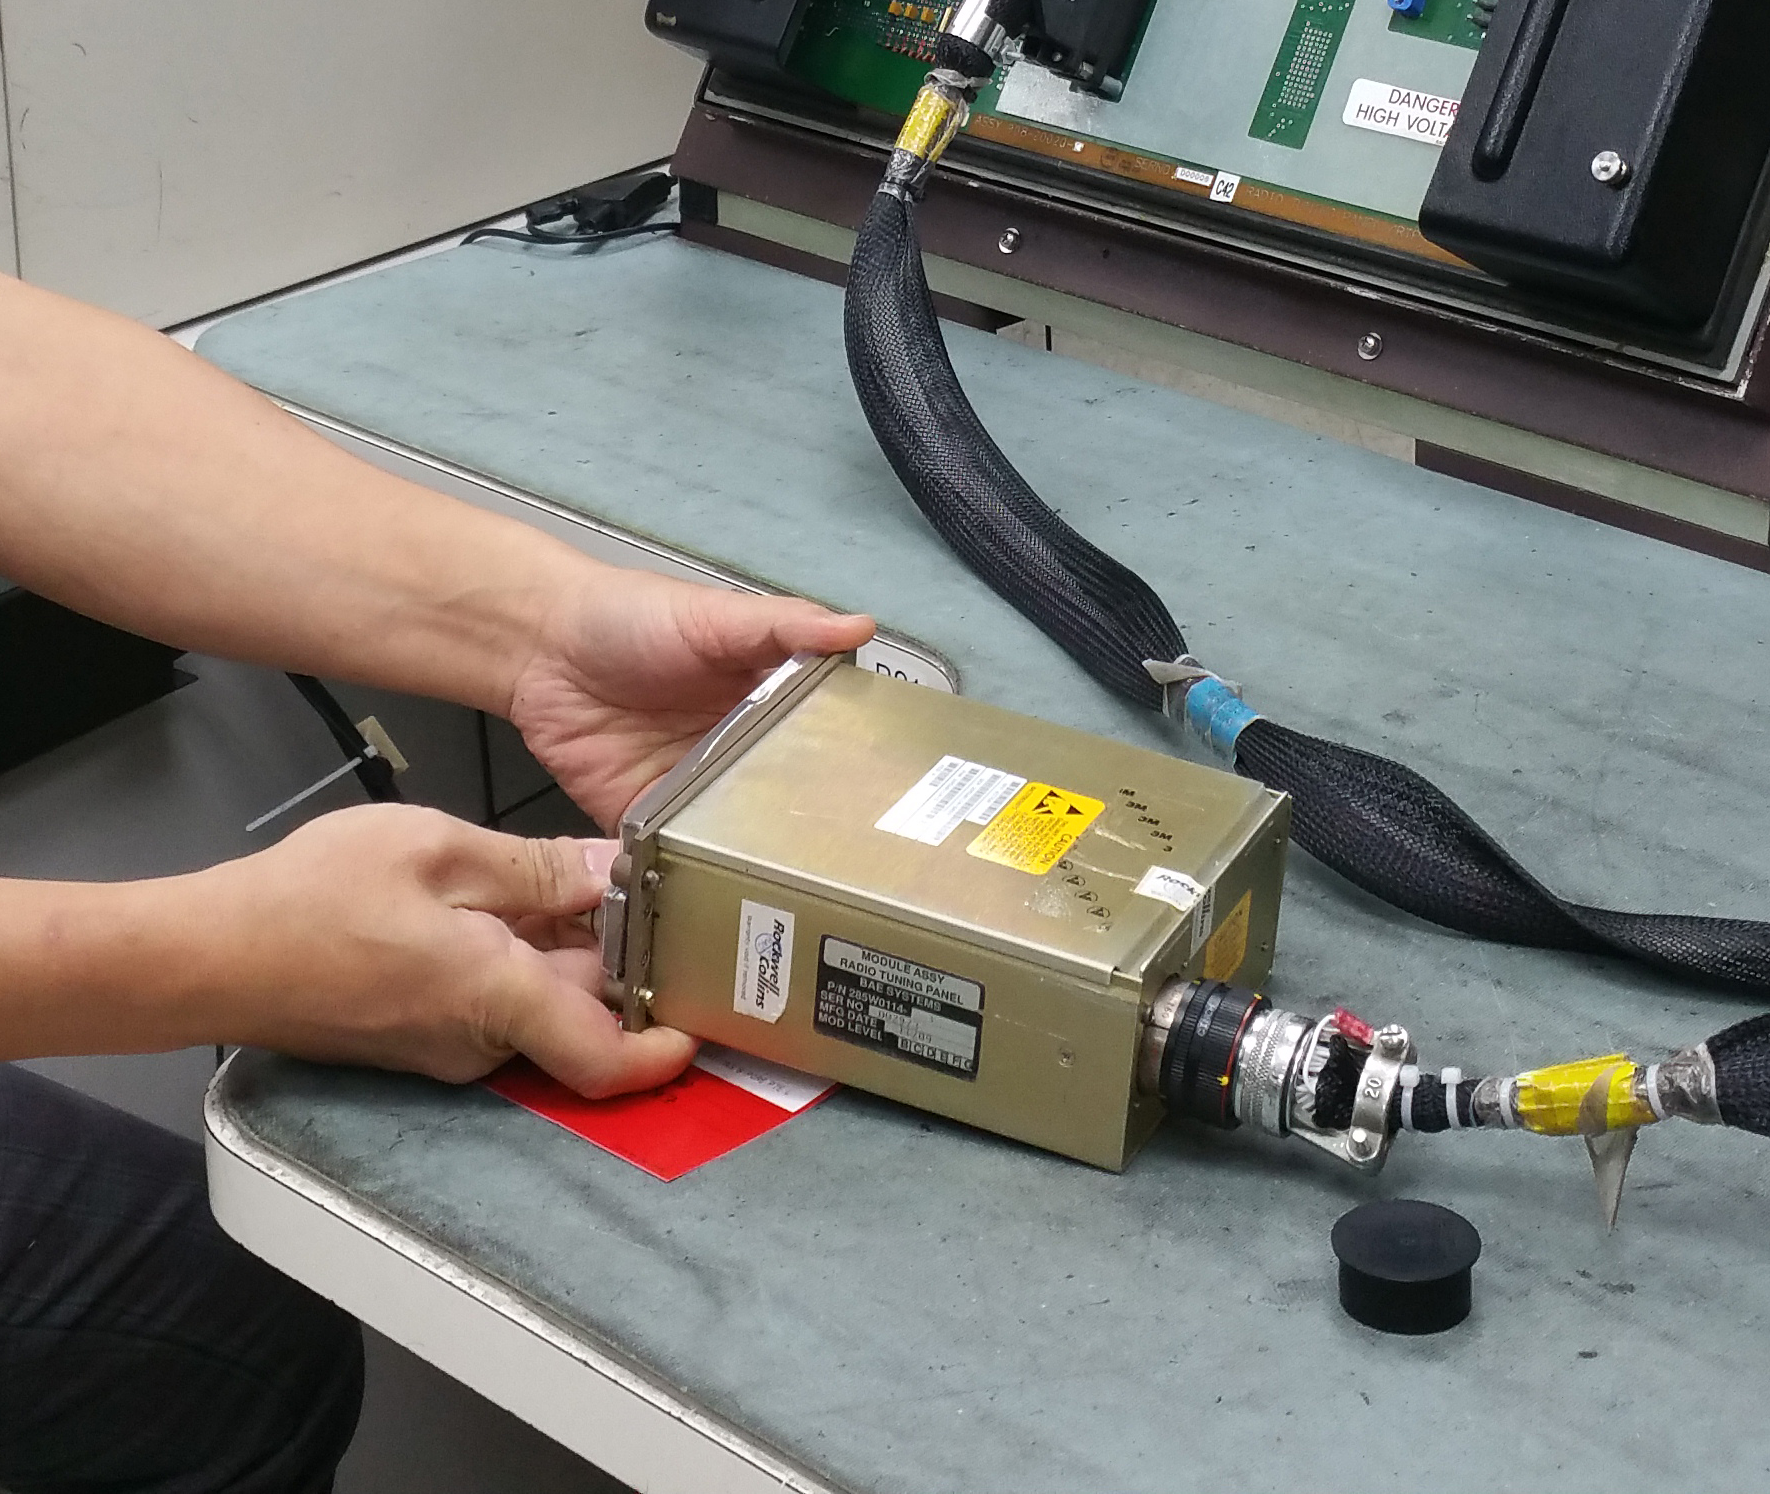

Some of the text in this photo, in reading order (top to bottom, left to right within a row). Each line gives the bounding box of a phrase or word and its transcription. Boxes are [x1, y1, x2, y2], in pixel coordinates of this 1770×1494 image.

[1356, 103, 1400, 127] HIGH
[1389, 88, 1461, 117] DANGER
[1215, 179, 1236, 198] C42
[1125, 801, 1148, 812] 3M
[1138, 815, 1160, 826] 3M
[1150, 830, 1173, 841] 3M
[1040, 833, 1073, 865] CAUTION
[771, 918, 785, 997] Rockwell
[861, 950, 945, 984] MODULE ASSY
[755, 955, 770, 1010] Collins
[827, 981, 846, 996] P/N
[840, 957, 964, 1005] RADIO TUNING PANEL
[820, 990, 844, 1006] SER
[846, 999, 864, 1012] NO
[859, 977, 942, 1012] BAE SYSTEMS
[818, 1012, 845, 1028] MOD
[847, 1019, 883, 1042] LEVEL
[819, 1001, 845, 1017] MFG
[847, 1008, 878, 1027] DATE
[1364, 1078, 1383, 1099] 20
